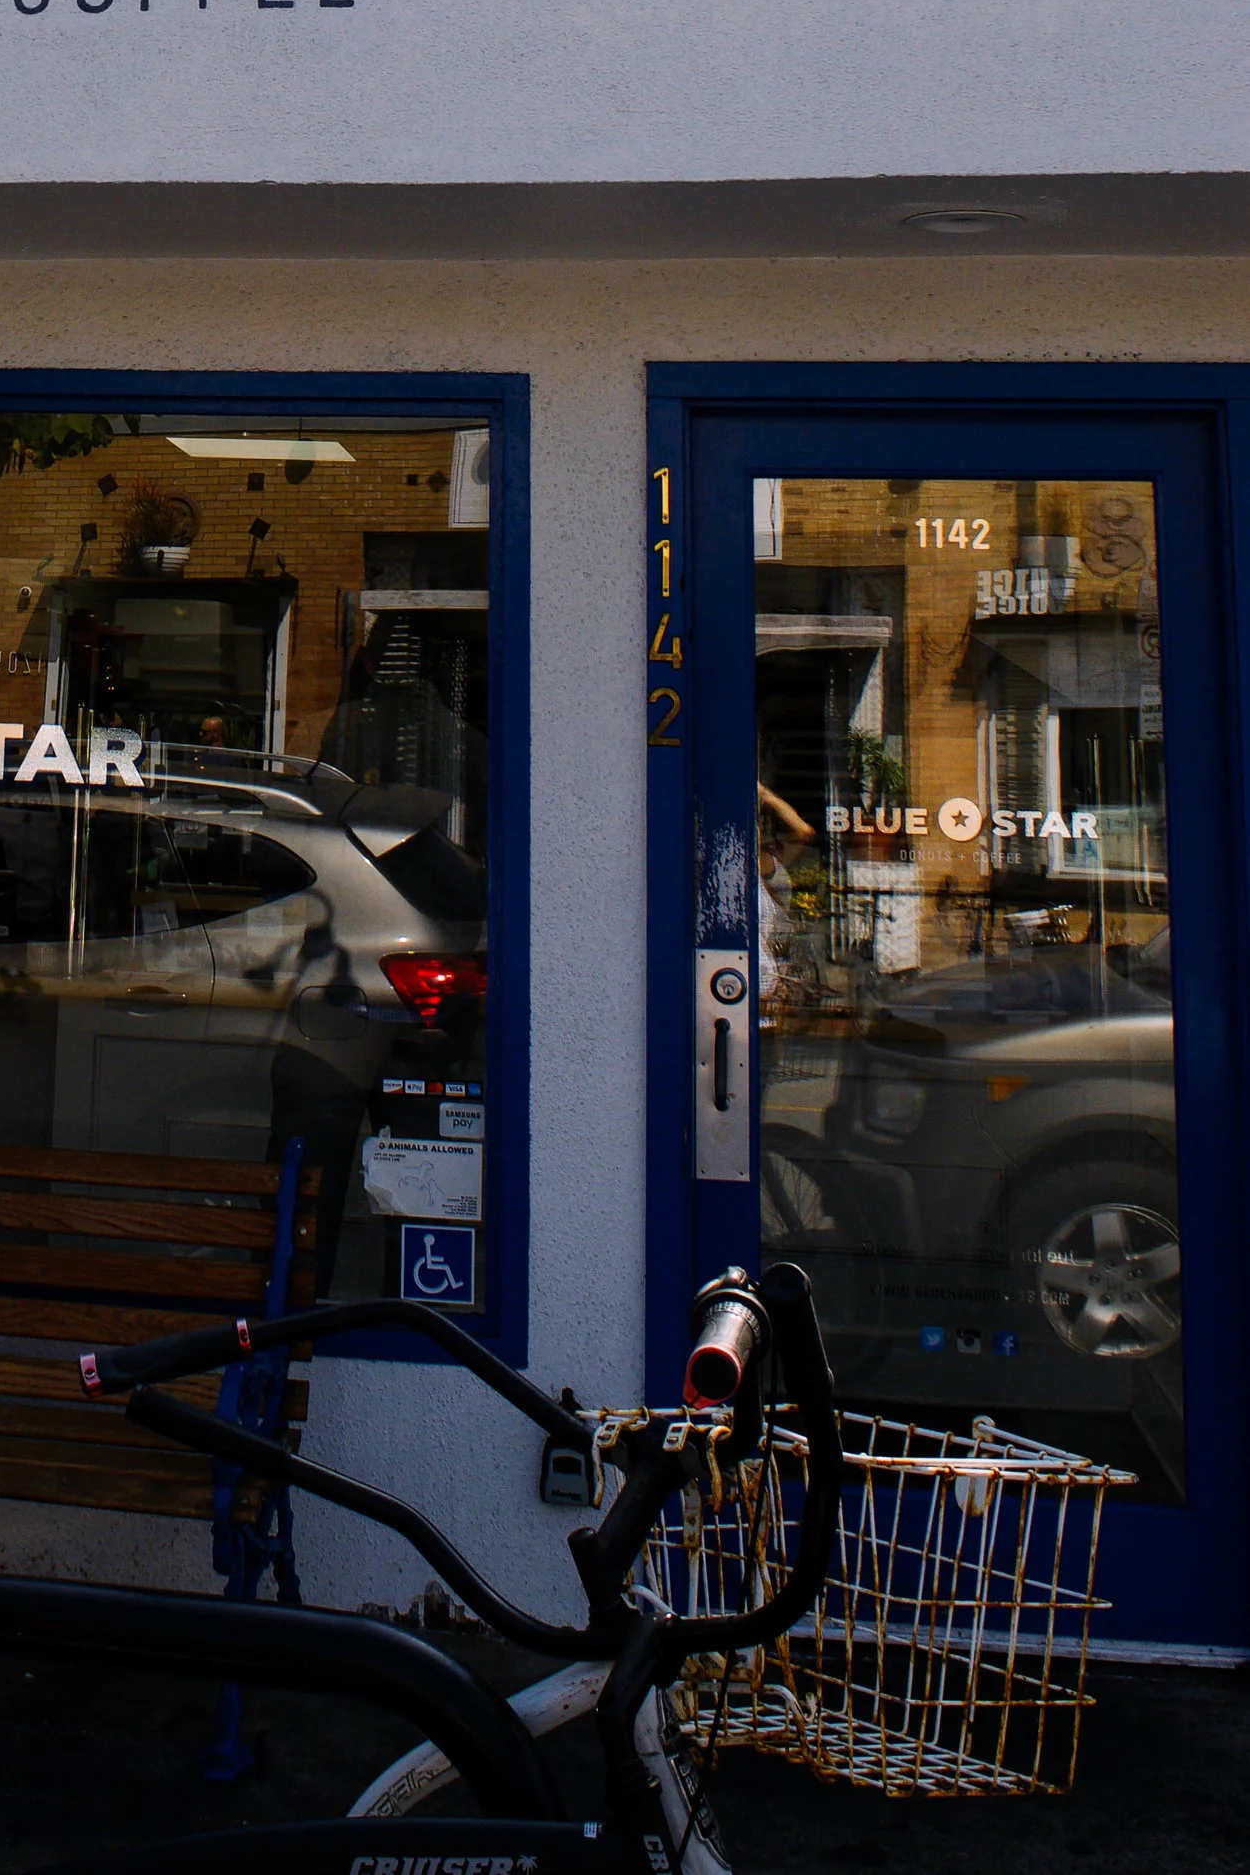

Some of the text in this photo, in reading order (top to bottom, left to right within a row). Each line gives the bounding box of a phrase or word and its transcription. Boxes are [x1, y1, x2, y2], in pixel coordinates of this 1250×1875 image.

[914, 517, 991, 551] 1142
[825, 805, 1099, 840] BLUE STAR
[899, 849, 952, 862] DONUTS
[972, 851, 1023, 864] COFFEE
[445, 1110, 481, 1119] SAMSUNG
[452, 1118, 473, 1129] pay
[388, 1142, 429, 1152] ANIMALS
[430, 1145, 475, 1155] ALLOWED
